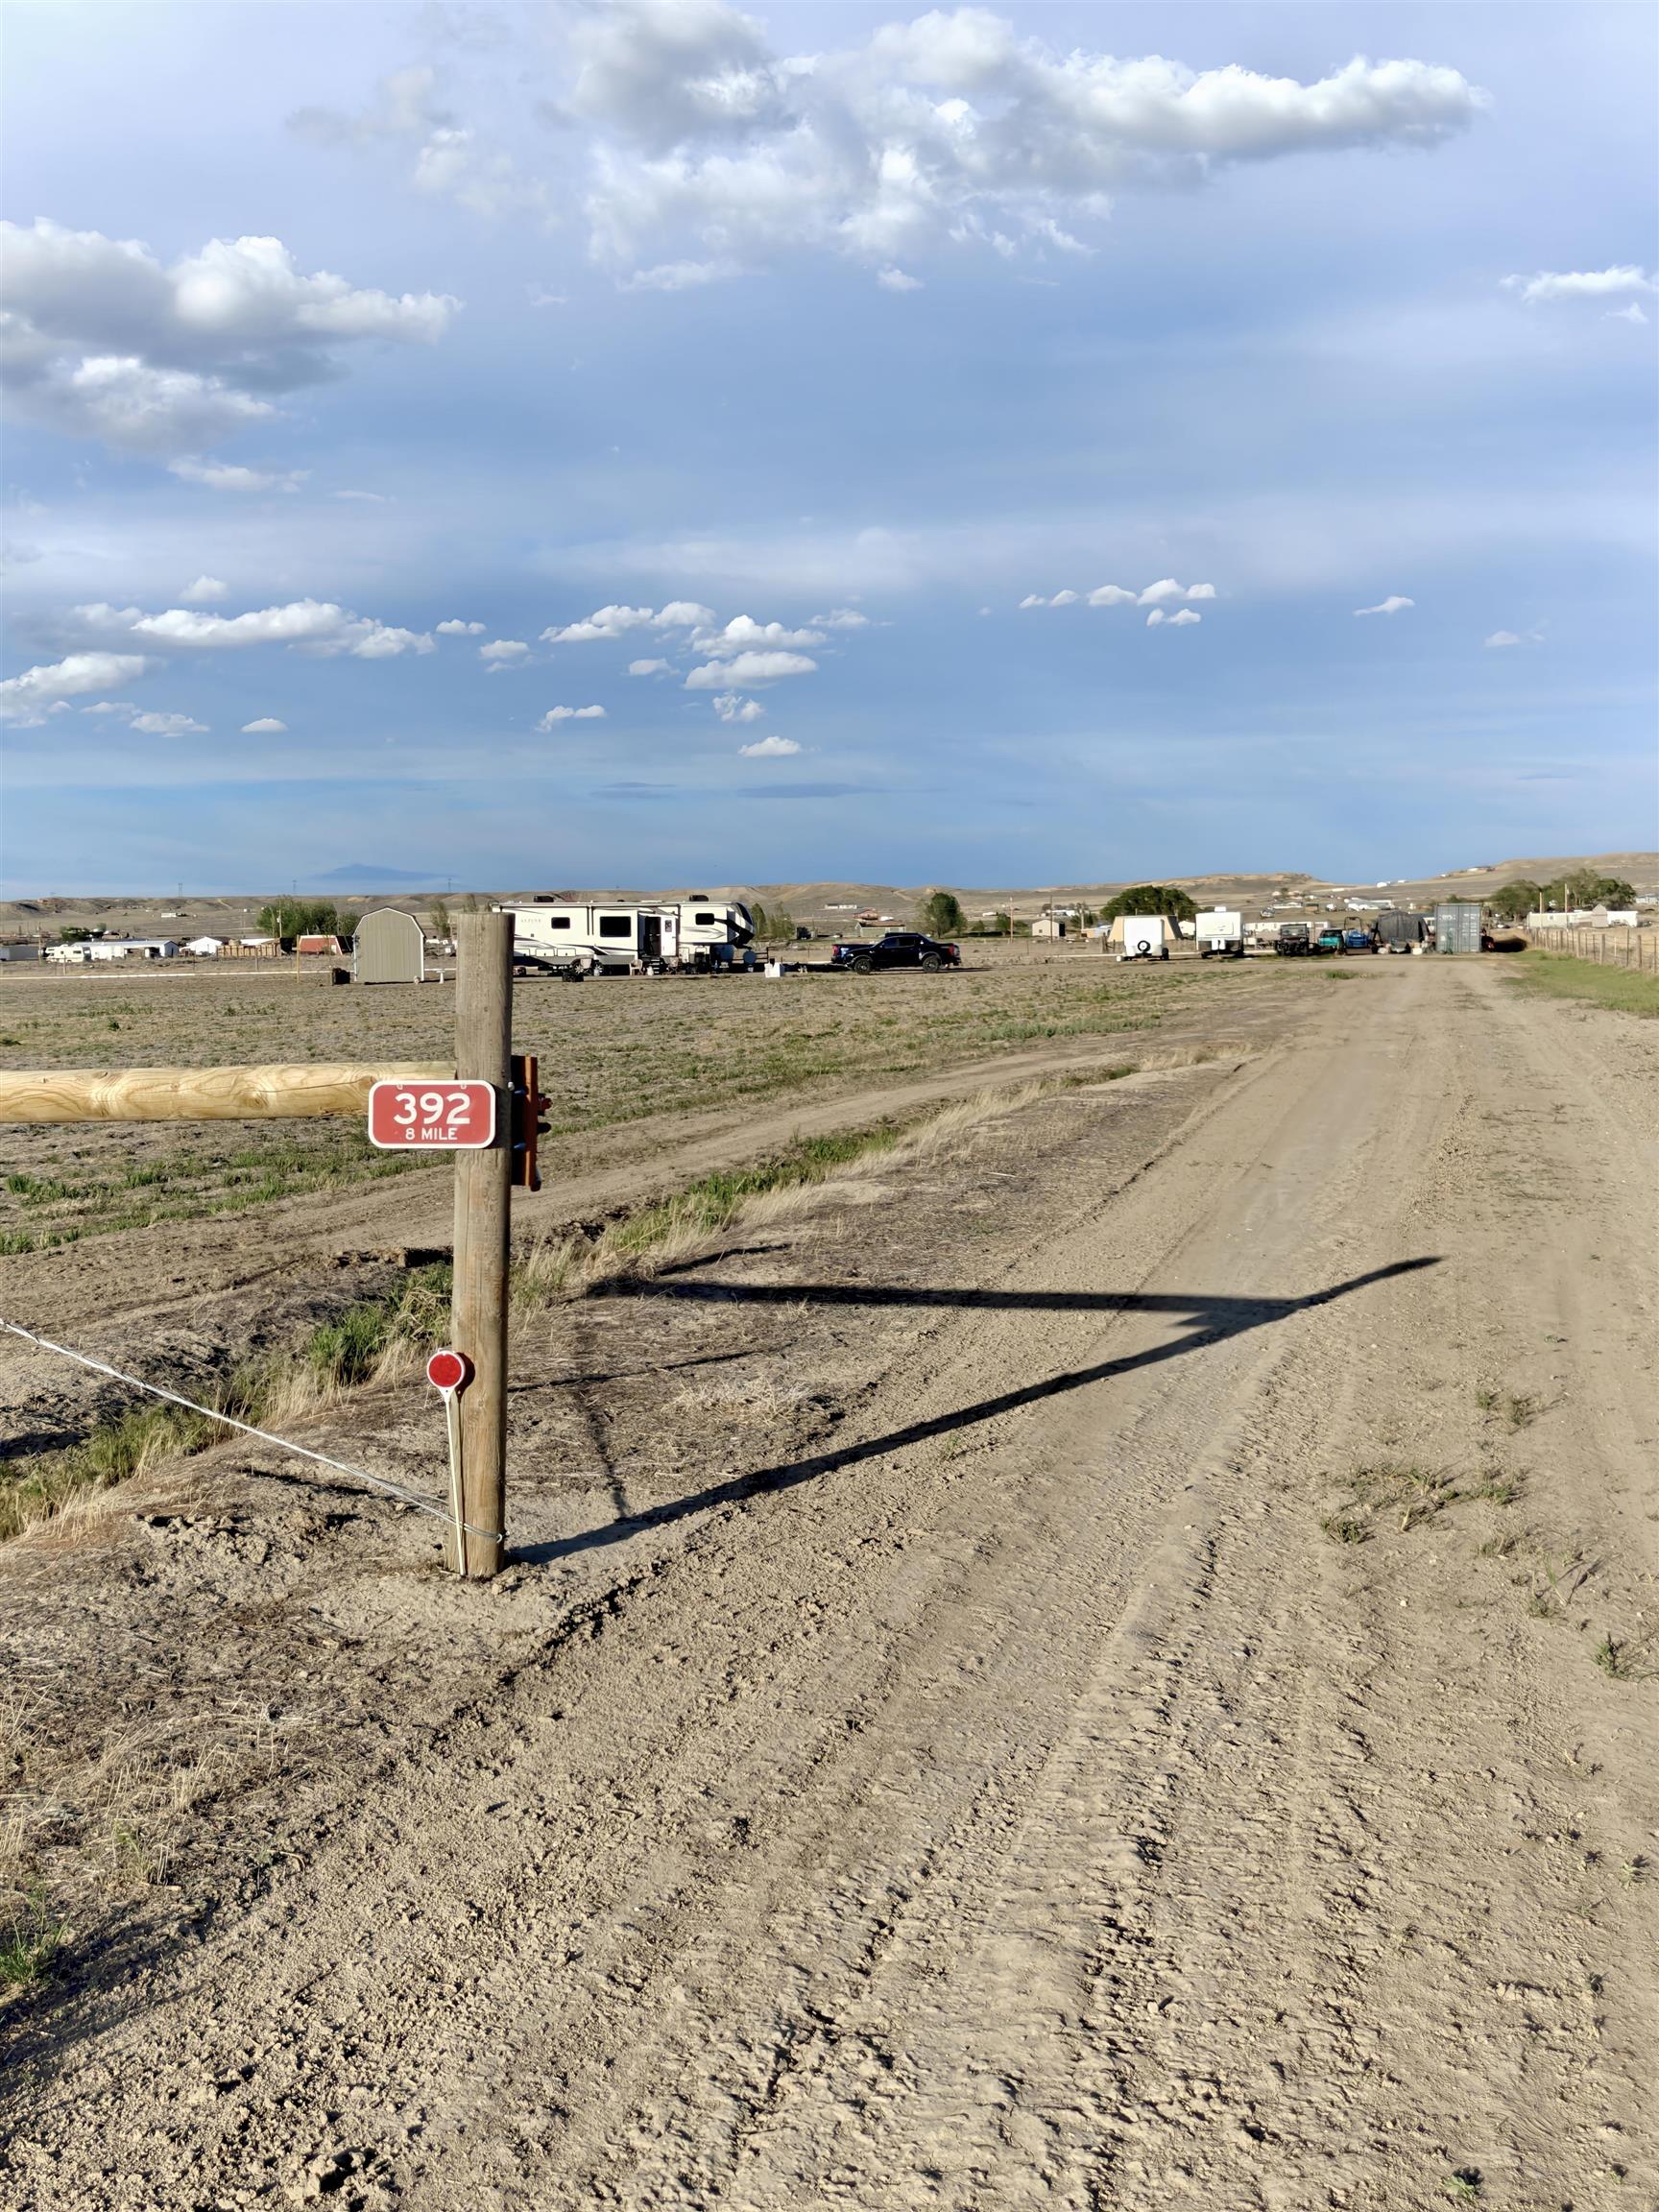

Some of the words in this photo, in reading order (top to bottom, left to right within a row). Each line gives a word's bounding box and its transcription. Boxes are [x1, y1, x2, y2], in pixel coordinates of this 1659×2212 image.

[394, 1093, 470, 1125] 392
[405, 1128, 415, 1141] 8
[421, 1128, 458, 1141] MILE
